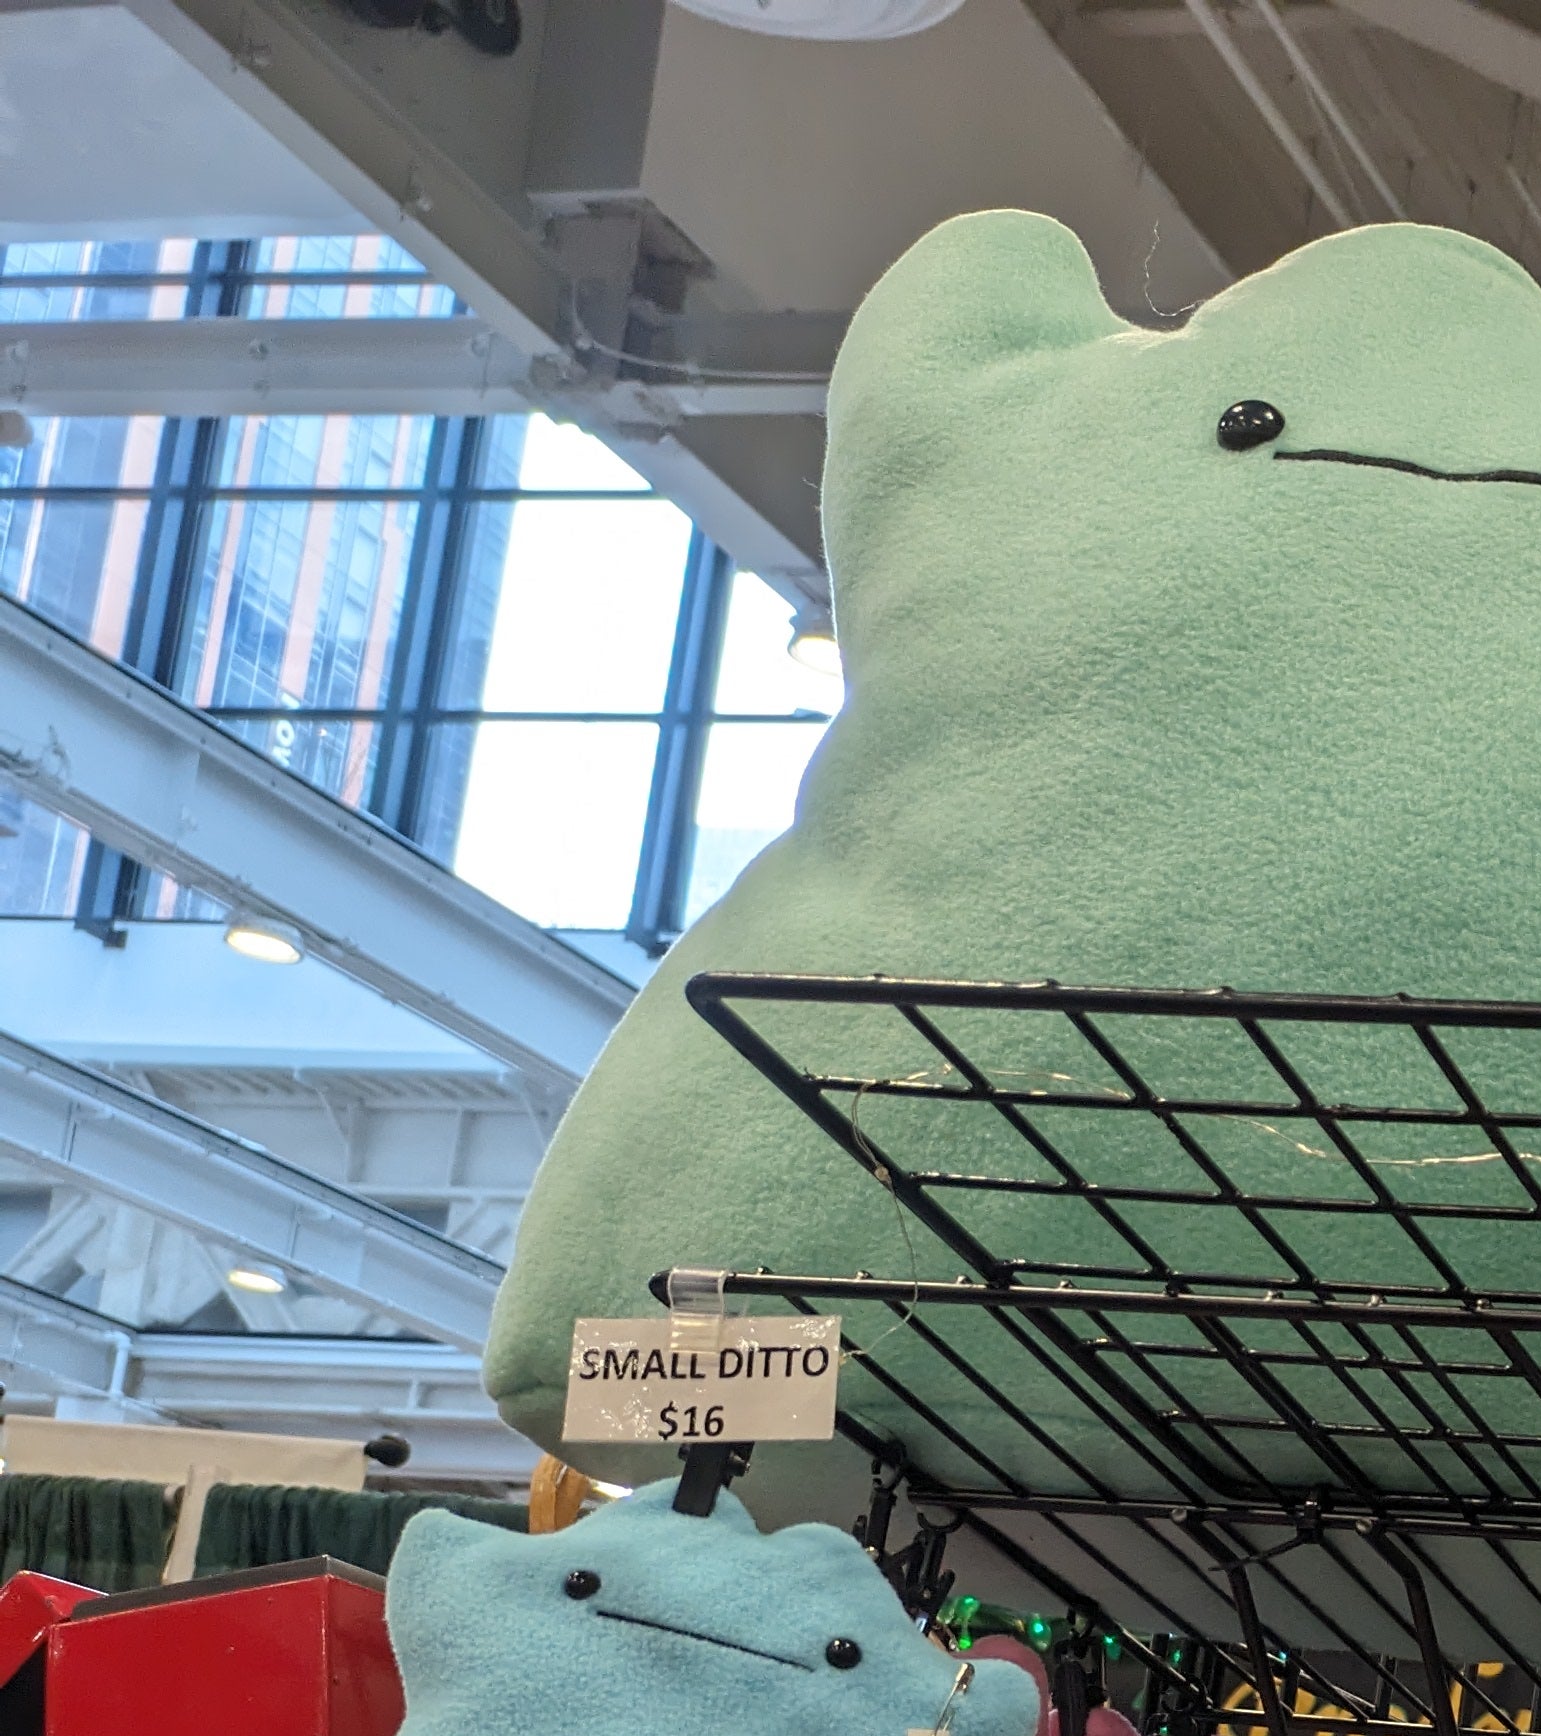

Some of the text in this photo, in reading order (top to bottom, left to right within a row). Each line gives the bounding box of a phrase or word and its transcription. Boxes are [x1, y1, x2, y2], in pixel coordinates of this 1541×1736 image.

[579, 1346, 829, 1380] SMALL DITTO
[658, 1401, 725, 1440] $16
